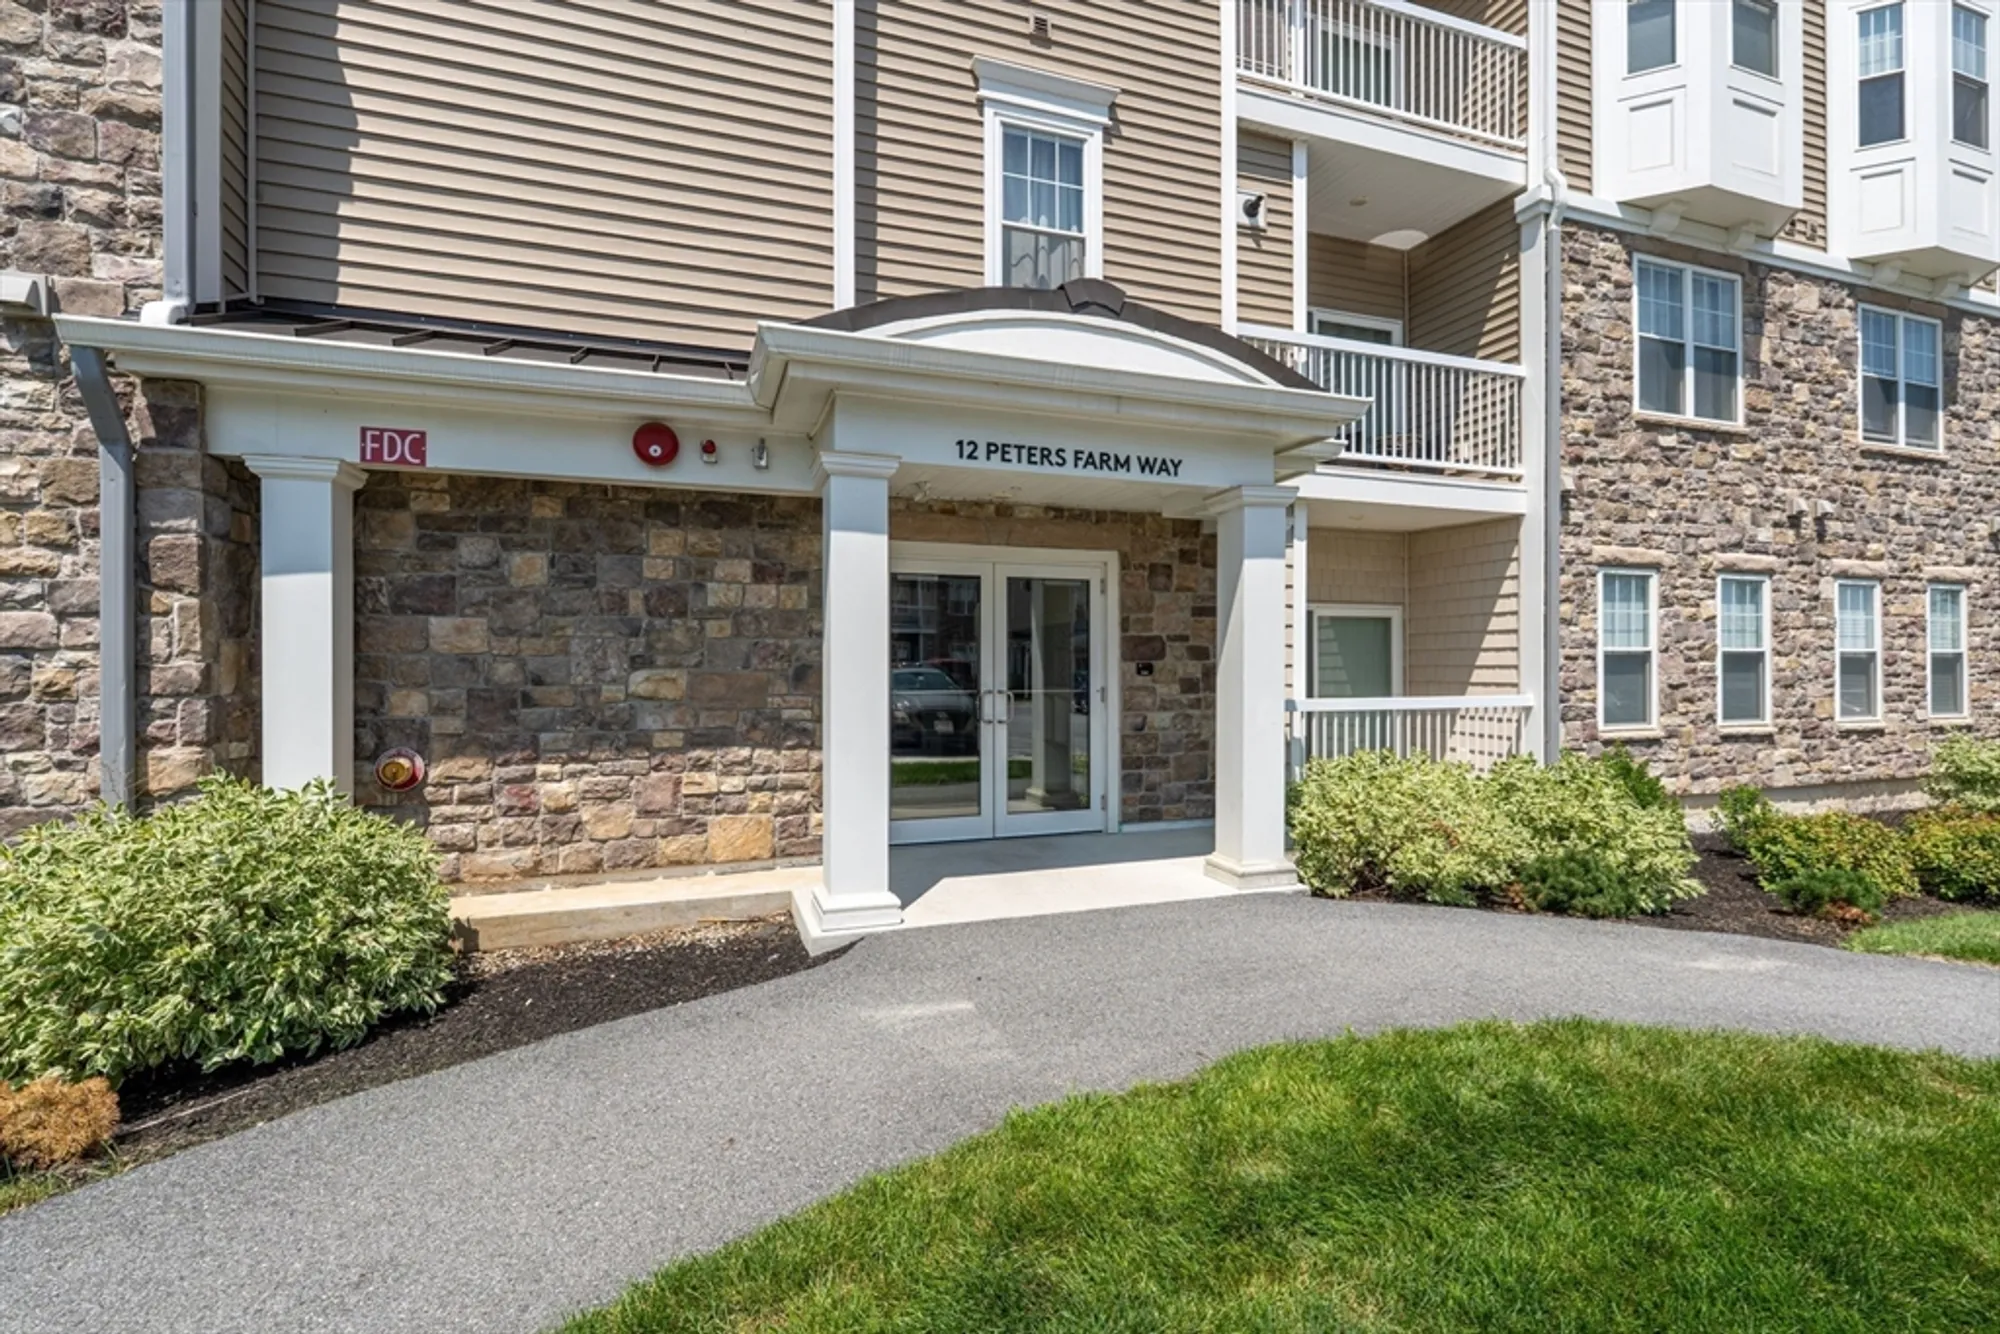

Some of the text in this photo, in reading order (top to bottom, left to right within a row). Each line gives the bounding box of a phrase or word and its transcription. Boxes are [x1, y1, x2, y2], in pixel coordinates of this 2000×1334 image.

[365, 430, 422, 464] FDC
[955, 439, 1183, 477] 12 PETERS FARM WAY
